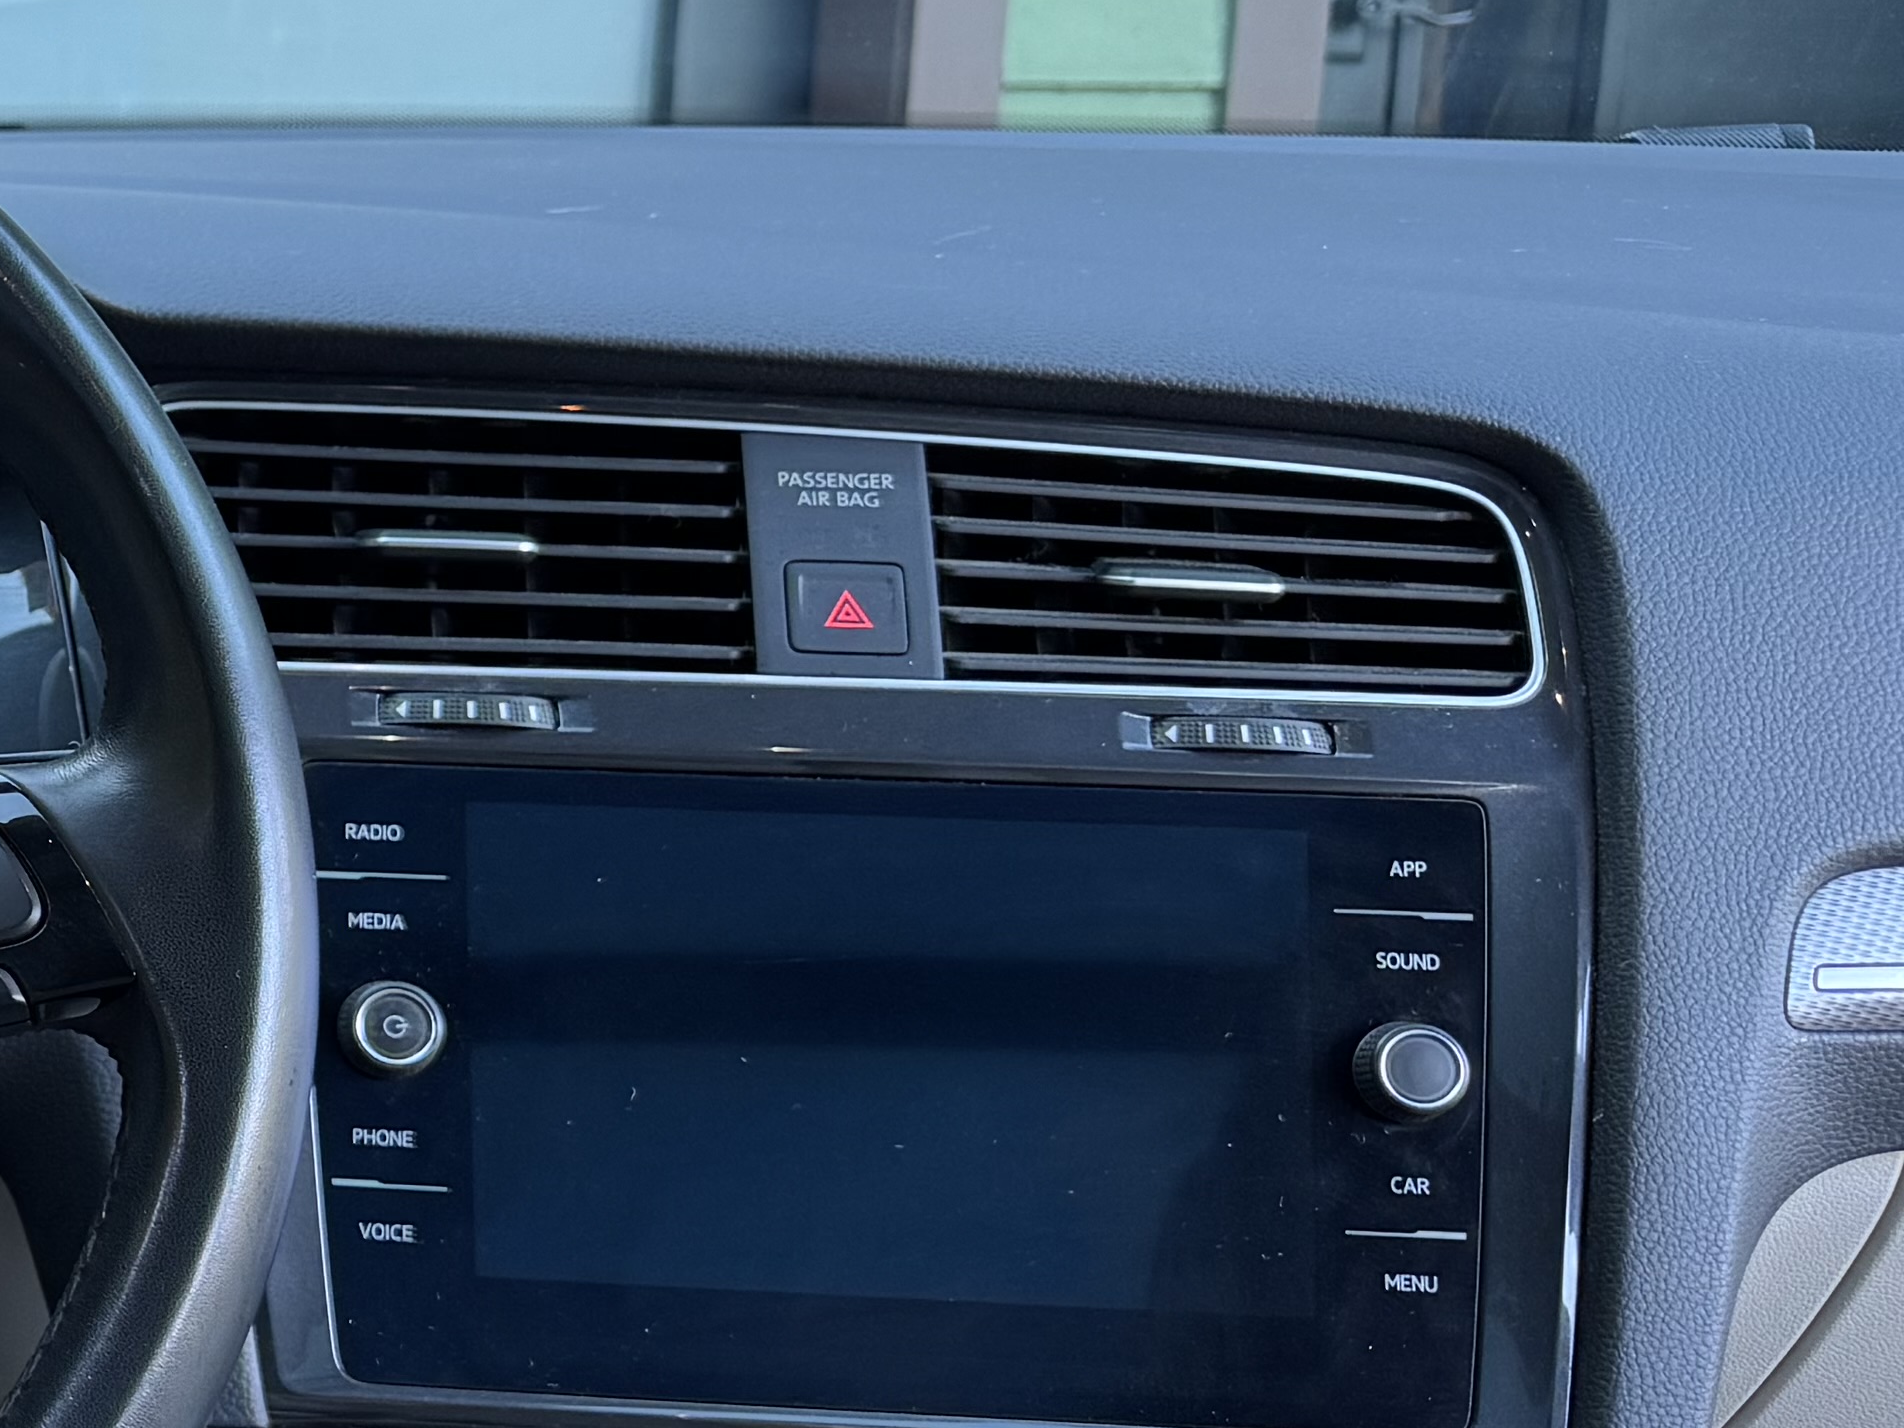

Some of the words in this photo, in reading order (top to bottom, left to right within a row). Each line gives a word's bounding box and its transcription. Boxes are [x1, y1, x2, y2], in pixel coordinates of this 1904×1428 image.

[778, 471, 894, 489] PASSENGER
[797, 491, 830, 506] AIR
[836, 491, 880, 508] BAG
[345, 823, 405, 842] RADIO
[1389, 860, 1427, 877] APP
[348, 912, 407, 930] MEDIA
[1376, 952, 1440, 971] SOUND
[352, 1128, 417, 1148] PHONE
[1391, 1176, 1430, 1195] CAR
[359, 1222, 418, 1243] VOICE
[1385, 1273, 1439, 1293] MENU
